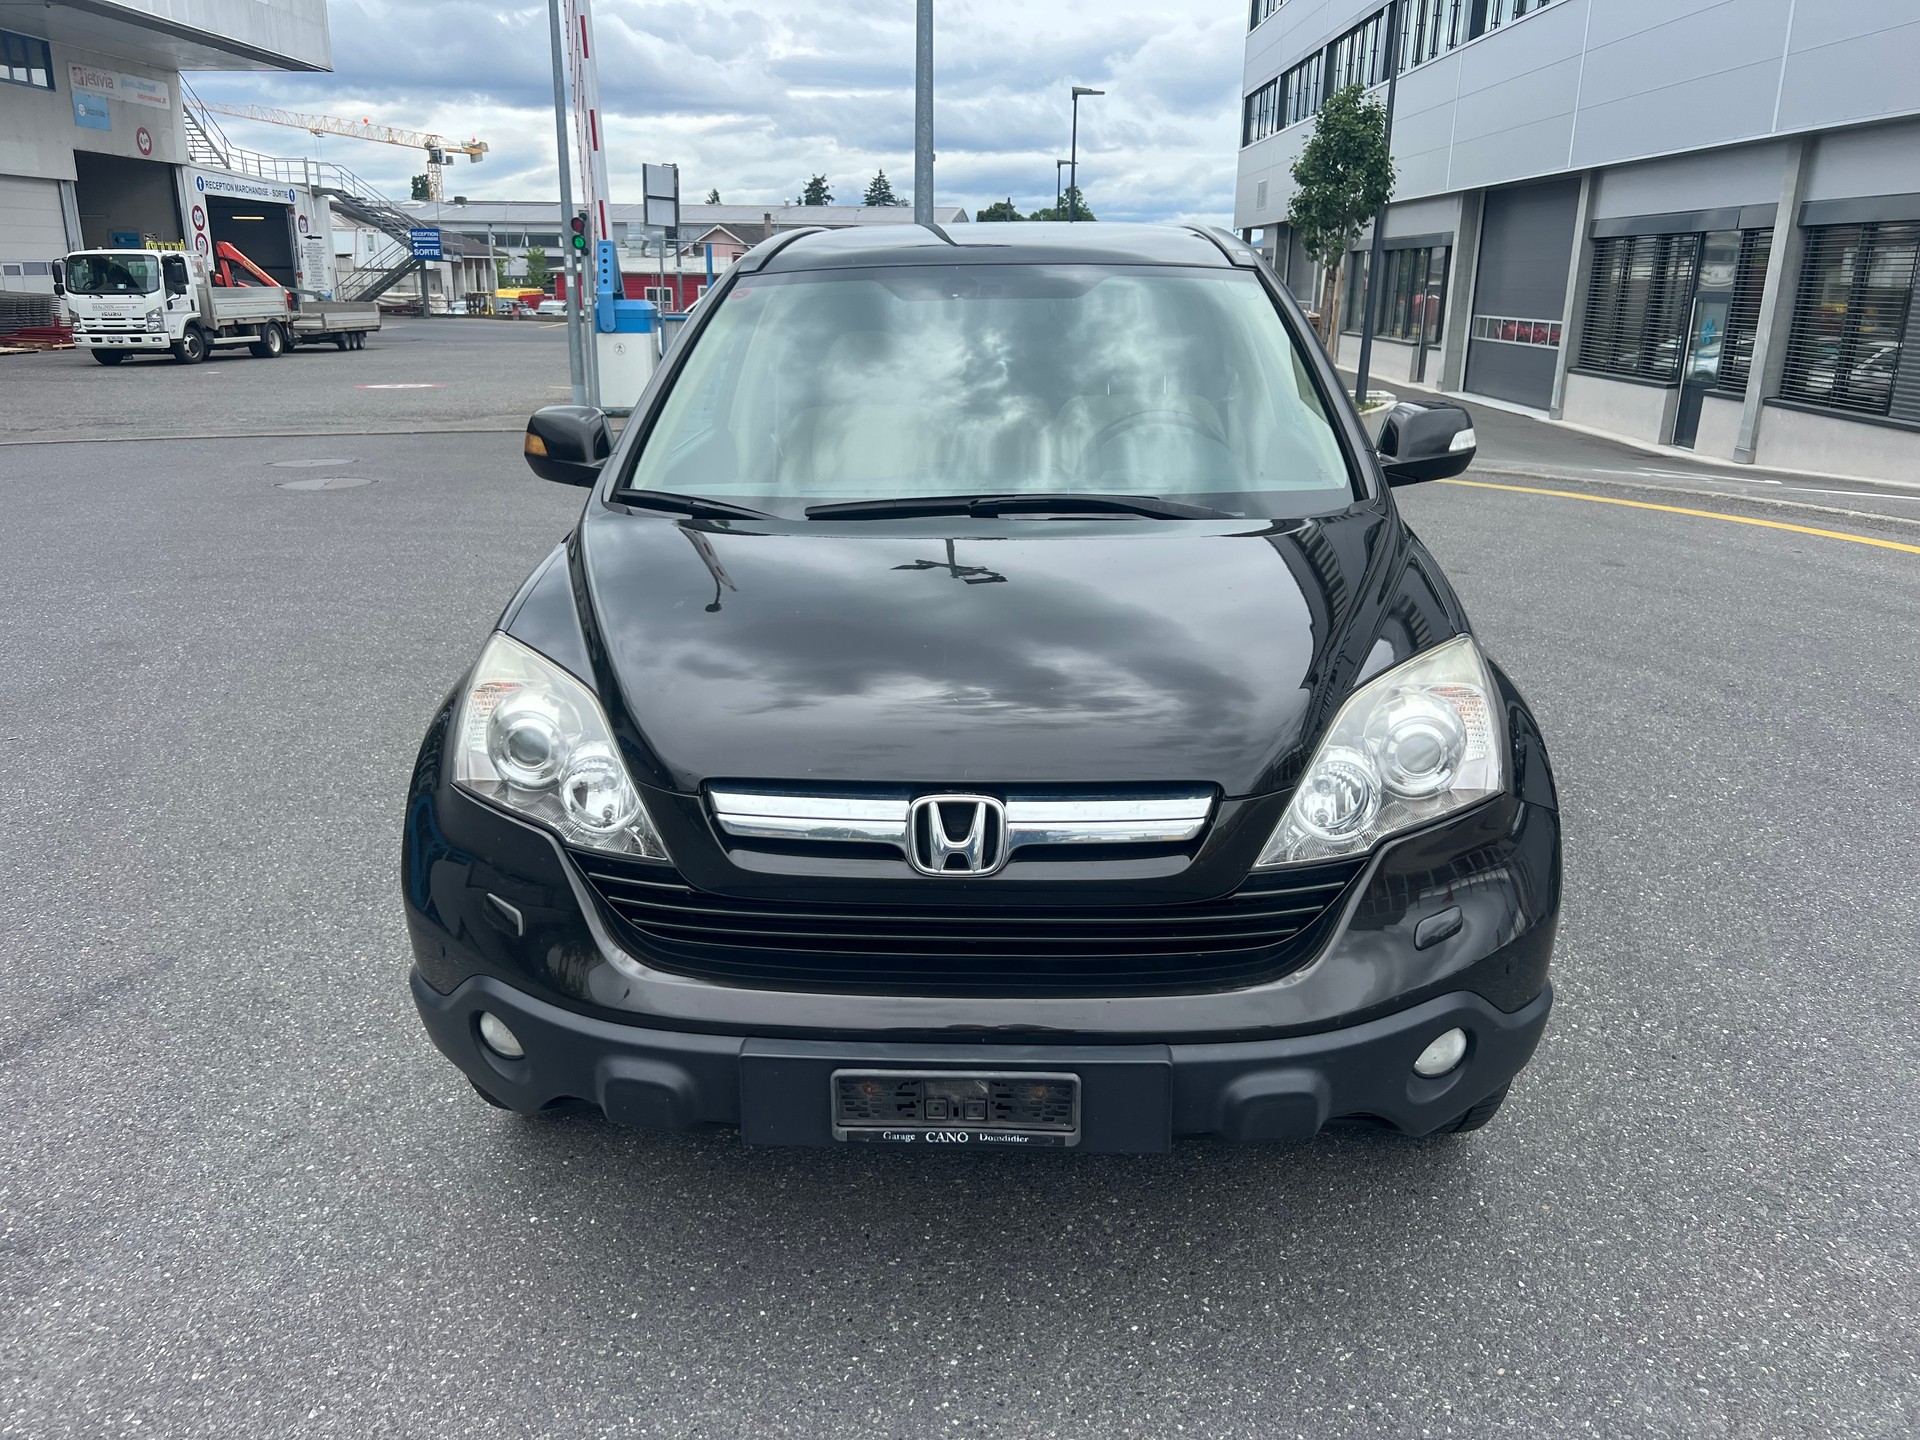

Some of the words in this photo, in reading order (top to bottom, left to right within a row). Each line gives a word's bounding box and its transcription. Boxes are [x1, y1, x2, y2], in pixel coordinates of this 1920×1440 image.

[205, 180, 235, 192] RECEPTION
[235, 184, 269, 197] MARCHANDISE
[272, 189, 289, 199] SORTIE
[883, 1131, 916, 1143] Garage
[925, 1131, 969, 1143] CANO
